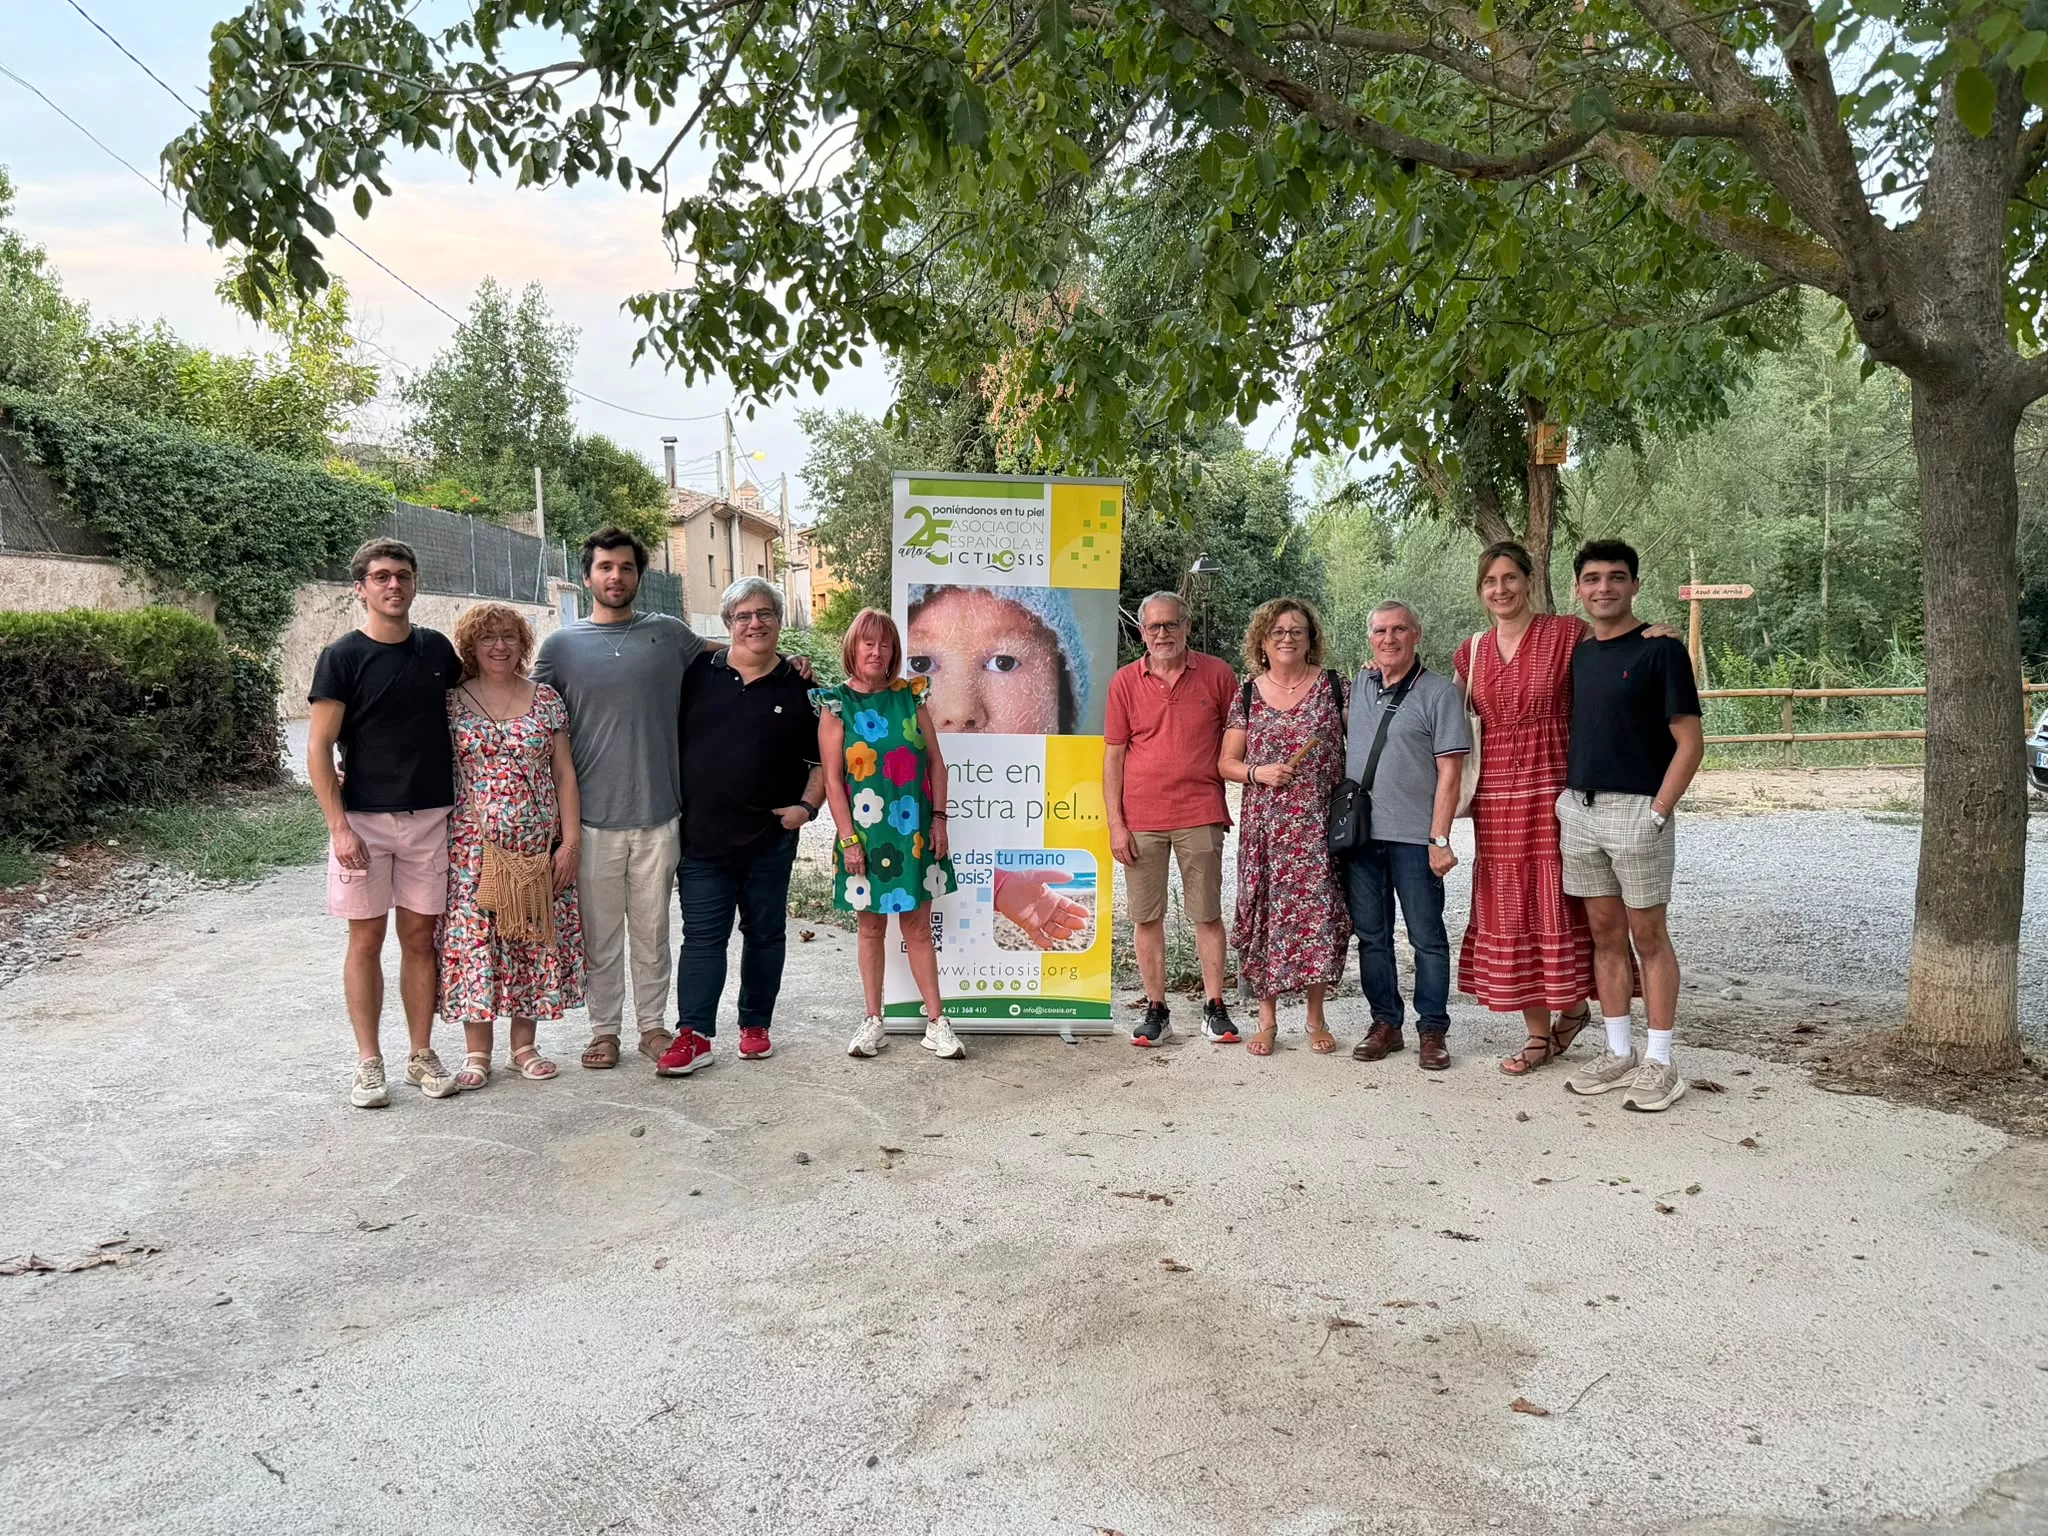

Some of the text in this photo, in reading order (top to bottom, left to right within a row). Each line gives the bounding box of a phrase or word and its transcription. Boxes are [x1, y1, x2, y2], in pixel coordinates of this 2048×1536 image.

[933, 505, 997, 517] poniéndonos
[1015, 508, 1025, 516] tu
[1027, 507, 1044, 518] piel
[951, 519, 1044, 534] ASOCIACIÓN
[902, 506, 953, 565] 25
[950, 534, 1031, 550] ESPAÑOLA
[898, 542, 934, 558] años
[946, 759, 1041, 783] nte en
[946, 792, 1099, 827] estra piel...
[965, 849, 993, 864] das
[996, 851, 1014, 865] tu
[1018, 852, 1065, 866] mano
[956, 868, 993, 884] osis?
[937, 962, 1078, 979] ww.ictiosis.org
[1023, 1006, 1077, 1015] info@ictiosis.org
